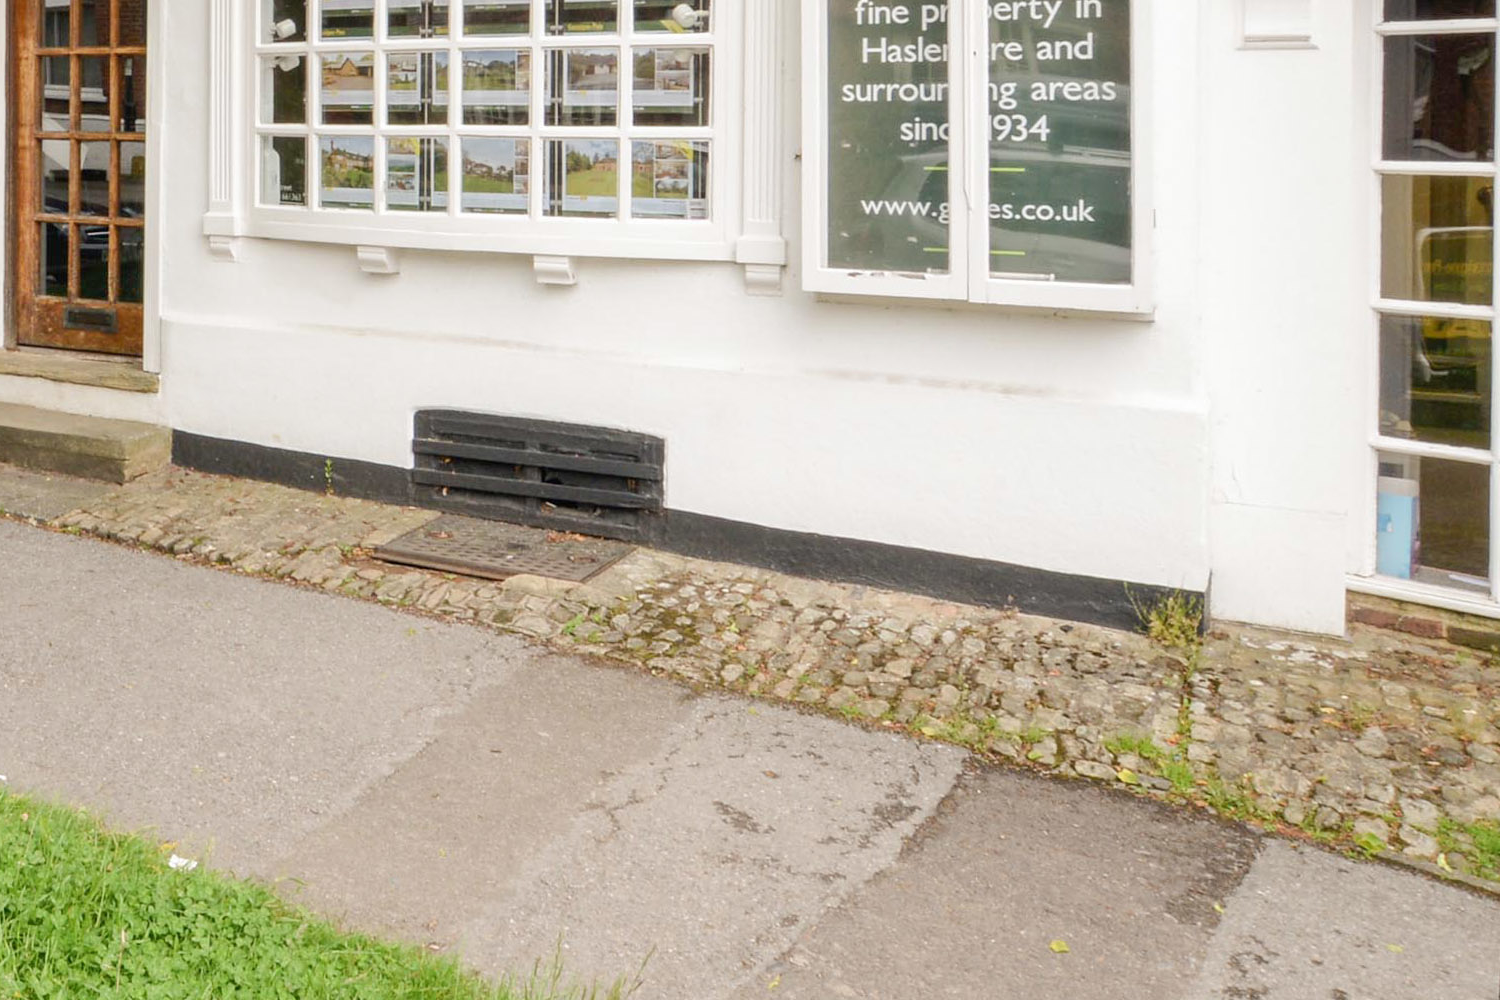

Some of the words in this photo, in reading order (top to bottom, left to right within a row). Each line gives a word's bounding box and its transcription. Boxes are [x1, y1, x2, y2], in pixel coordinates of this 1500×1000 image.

[855, 0, 909, 25] fine
[862, 37, 1023, 63] Haslere
[1036, 32, 1094, 60] and
[1031, 80, 1117, 101] areas
